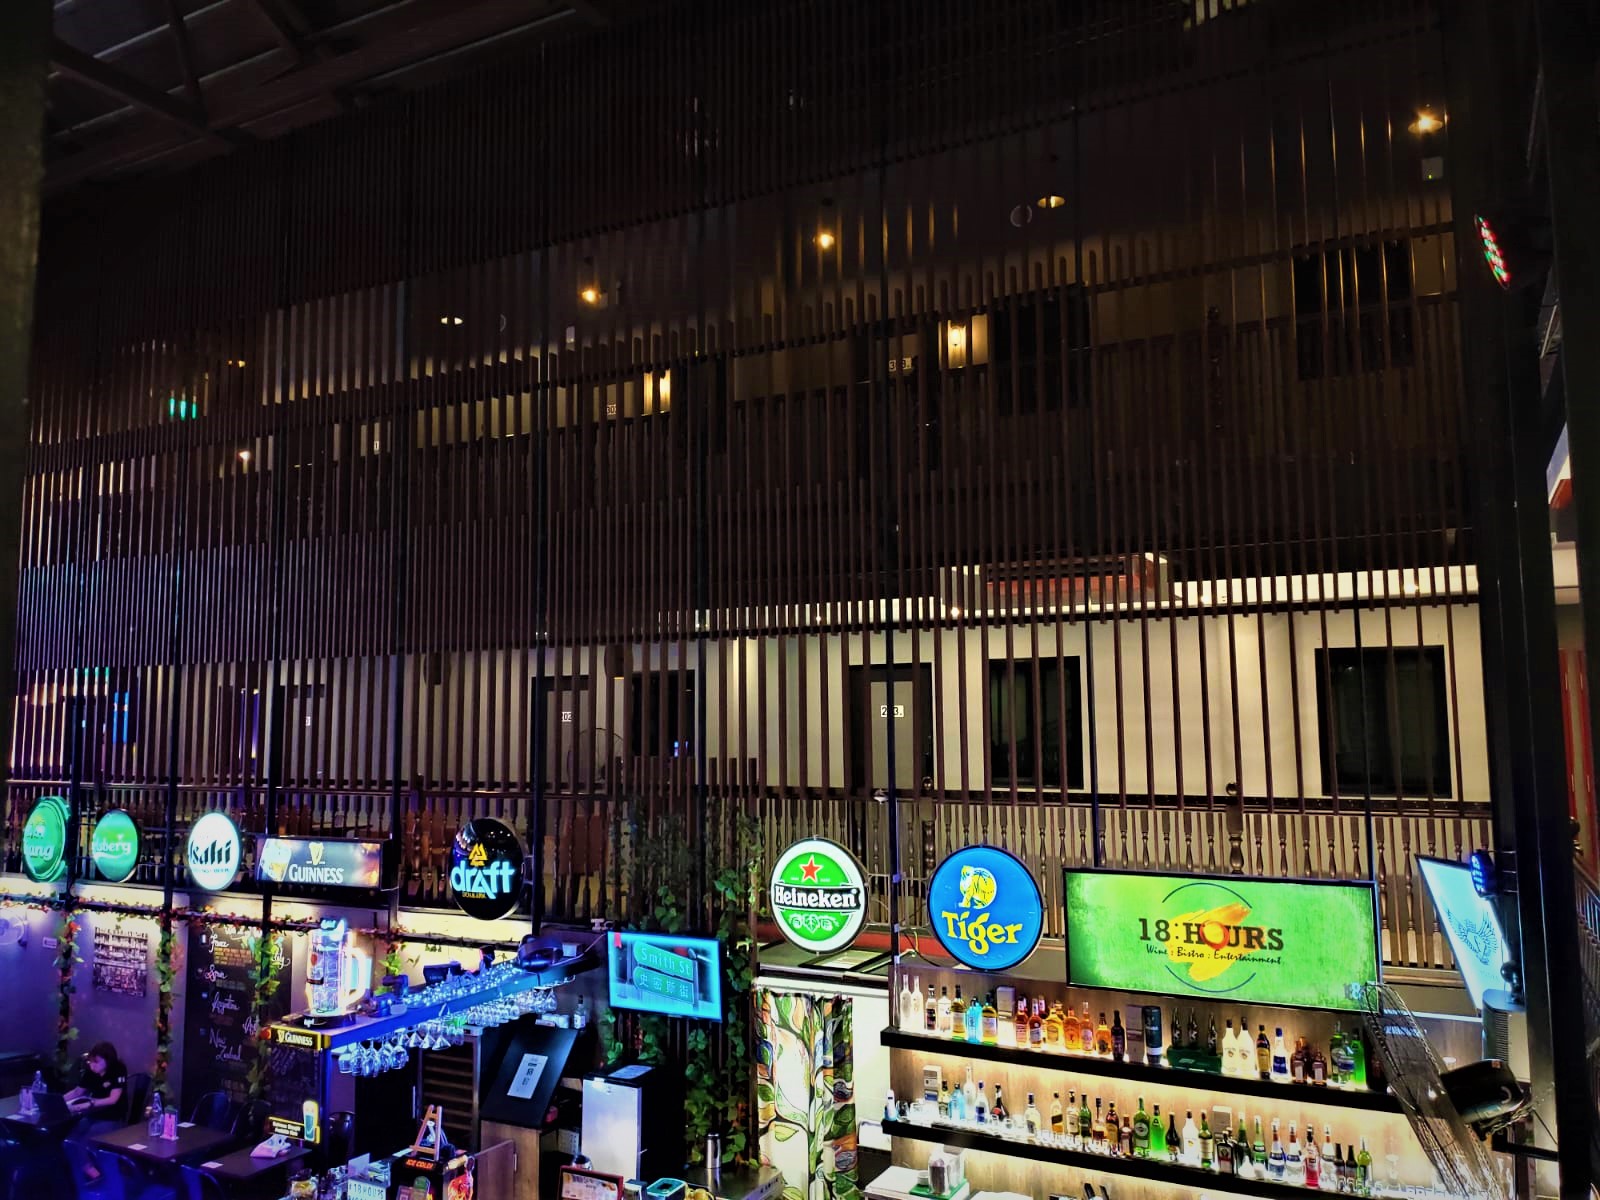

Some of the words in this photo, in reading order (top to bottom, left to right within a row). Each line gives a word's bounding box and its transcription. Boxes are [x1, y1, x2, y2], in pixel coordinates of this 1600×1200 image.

[289, 863, 344, 884] GUINNESS
[450, 860, 516, 900] draft
[774, 885, 856, 909] Heineken
[942, 911, 1023, 955] Tiger
[641, 947, 675, 970] Smith
[679, 962, 690, 976] St
[1146, 943, 1169, 956] Wine
[1176, 946, 1205, 959] Bistro
[1213, 950, 1282, 966] Entertainment
[284, 1032, 313, 1047] GUINNESS
